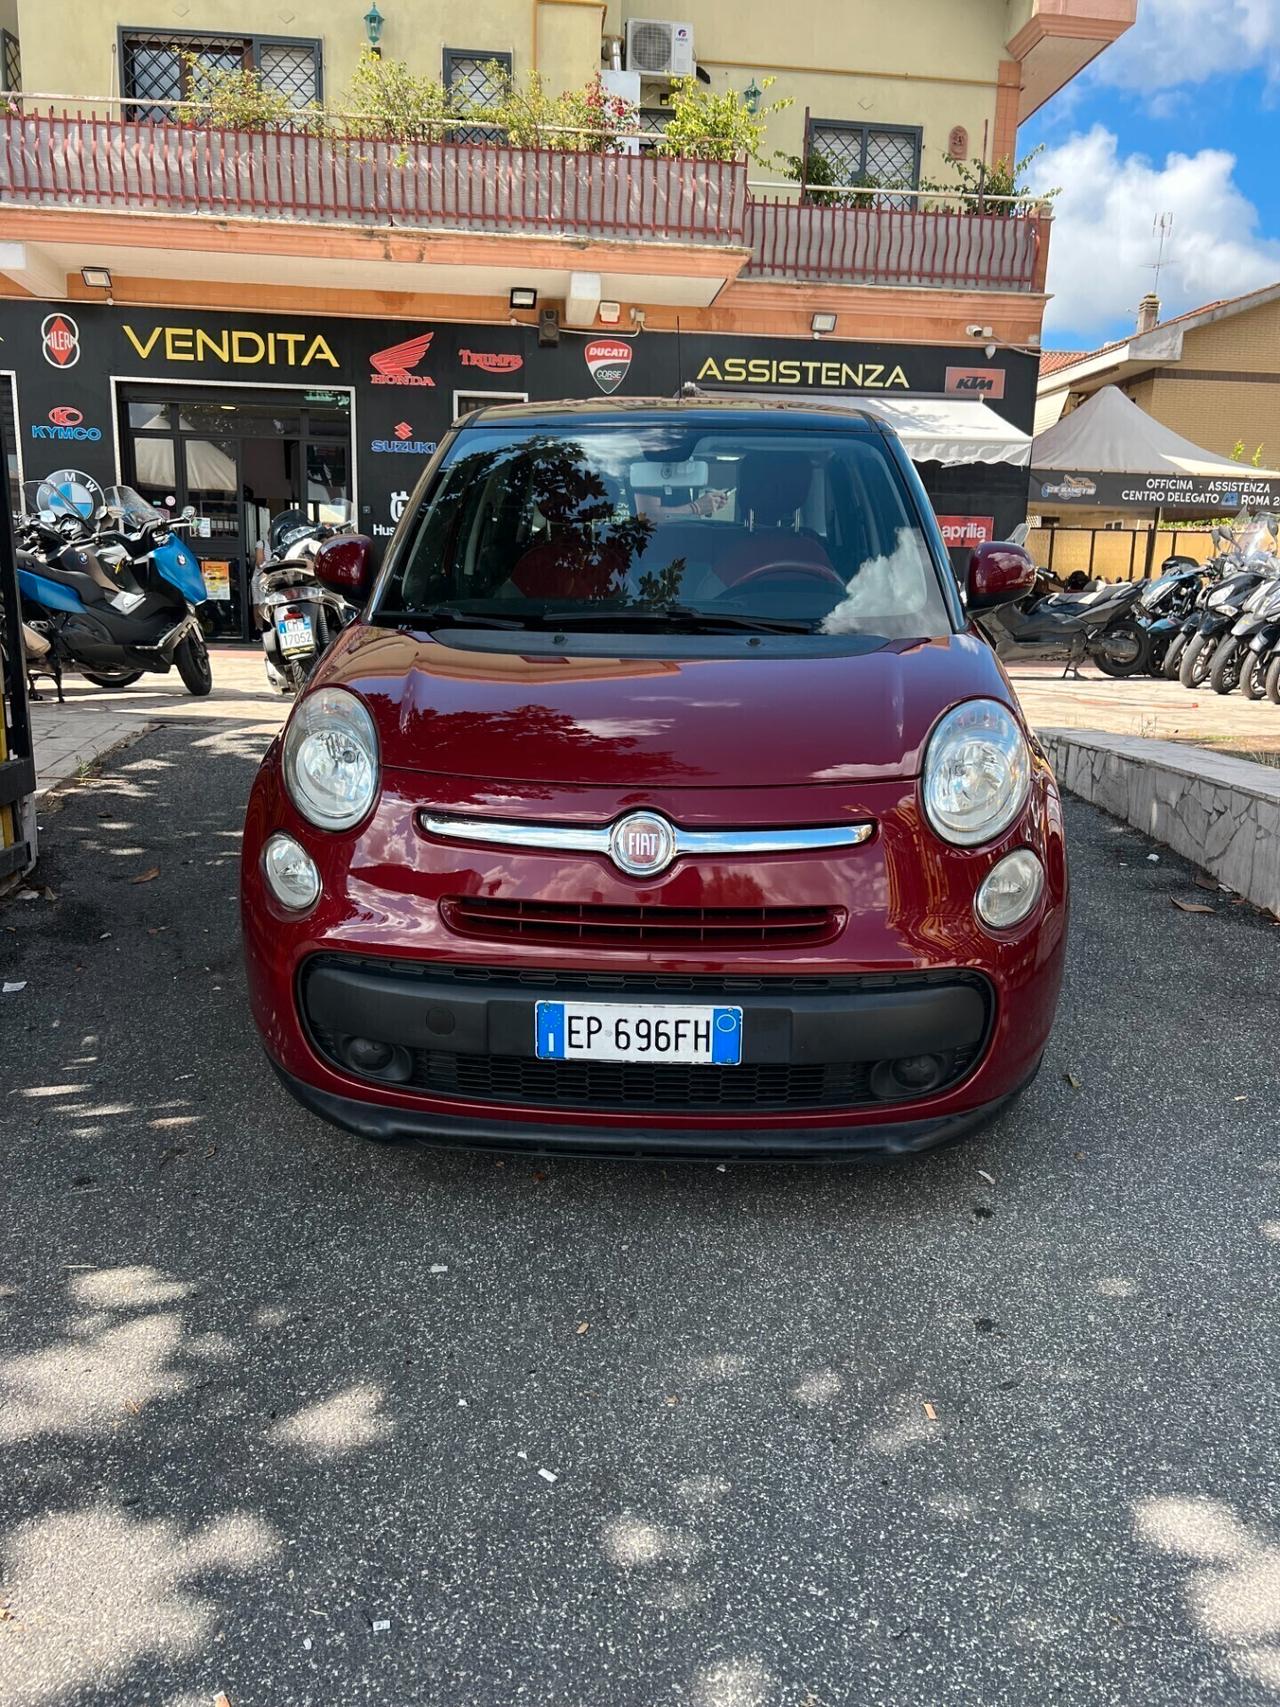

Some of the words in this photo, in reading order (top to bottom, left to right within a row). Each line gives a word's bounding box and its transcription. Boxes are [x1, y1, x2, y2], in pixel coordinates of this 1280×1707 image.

[122, 325, 340, 367] VENDITA
[589, 347, 628, 357] DUCATI
[458, 349, 523, 371] TRIUMPH
[370, 374, 436, 387] HONDA
[597, 369, 622, 379] CORSE
[696, 357, 910, 388] ASSISTENZA
[956, 376, 993, 390] KTM
[31, 425, 102, 441] KYMCO
[371, 439, 436, 454] SUZUKI
[1146, 478, 1194, 490] OFFICINA
[1207, 480, 1270, 493] ASSISTENZA
[1121, 490, 1165, 502] CENTRO
[1167, 492, 1220, 504] DELEGATO
[1241, 494, 1270, 506] ROMA
[1272, 496, 1280, 506] 2
[372, 523, 396, 536] Hus
[942, 522, 986, 540] aprilia
[628, 832, 659, 856] FIAT
[568, 1015, 603, 1049] EP
[614, 1018, 710, 1053] 696FH
